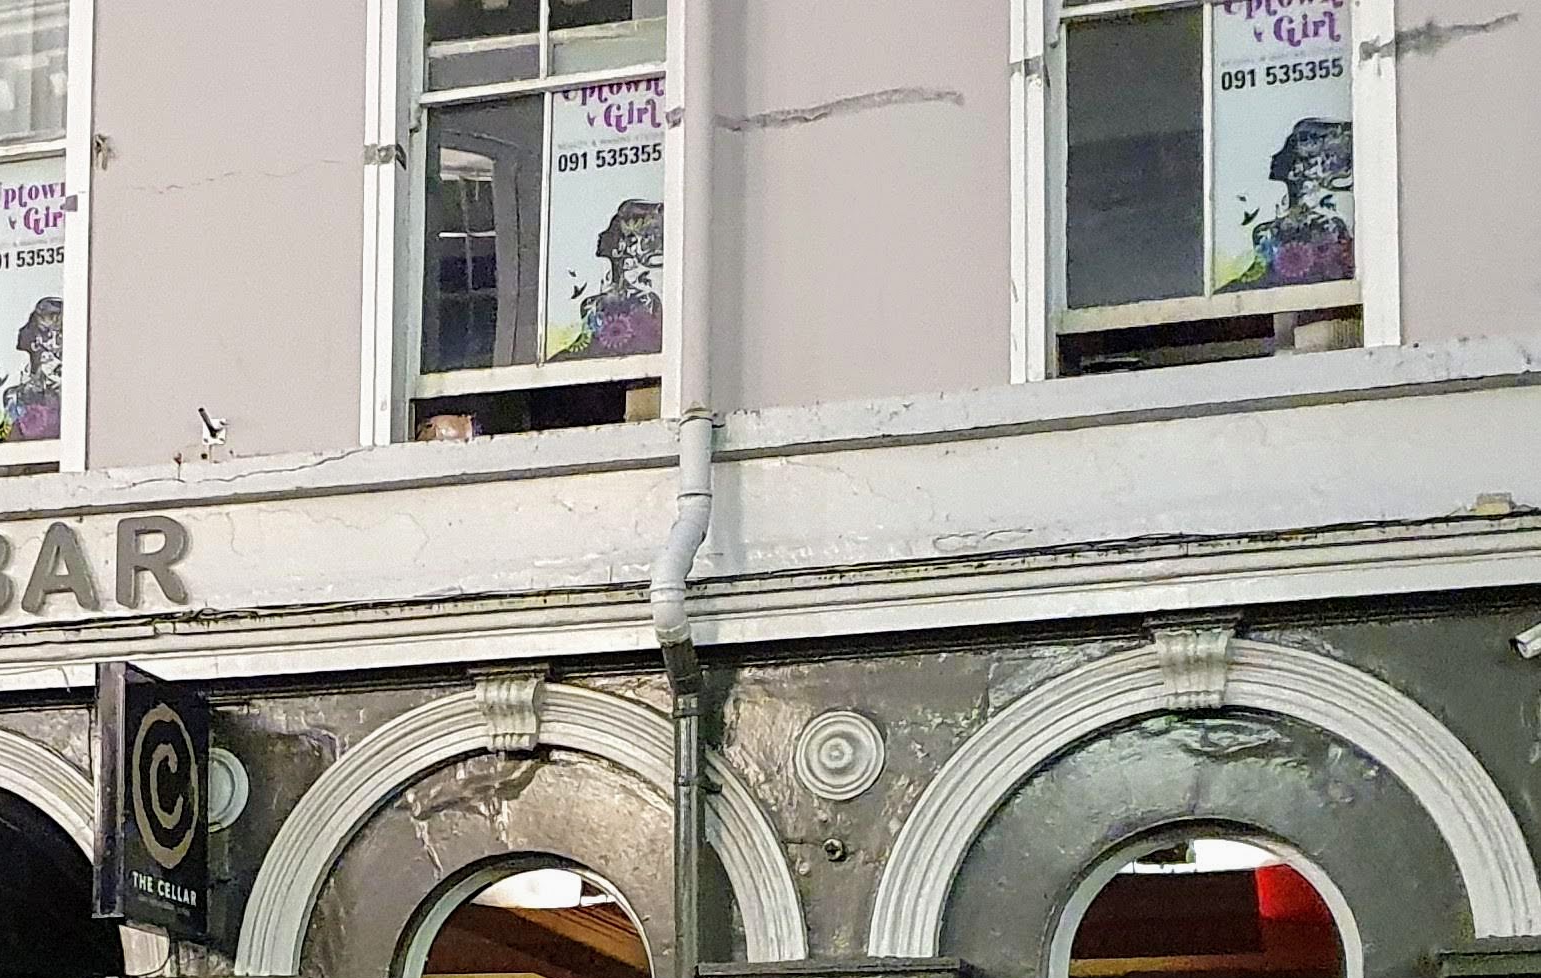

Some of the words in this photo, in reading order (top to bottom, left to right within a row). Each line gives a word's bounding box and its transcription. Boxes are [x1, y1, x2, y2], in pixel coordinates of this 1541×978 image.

[1273, 11, 1342, 47] Girl
[1221, 68, 1256, 91] 091
[1265, 58, 1344, 86] 535355
[603, 99, 662, 133] Girl
[558, 152, 588, 172] 091
[595, 142, 662, 168] 535355
[23, 204, 65, 235] Gir
[15, 245, 65, 268] 53535
[132, 870, 154, 893] THE
[157, 879, 197, 907] CELLAR
